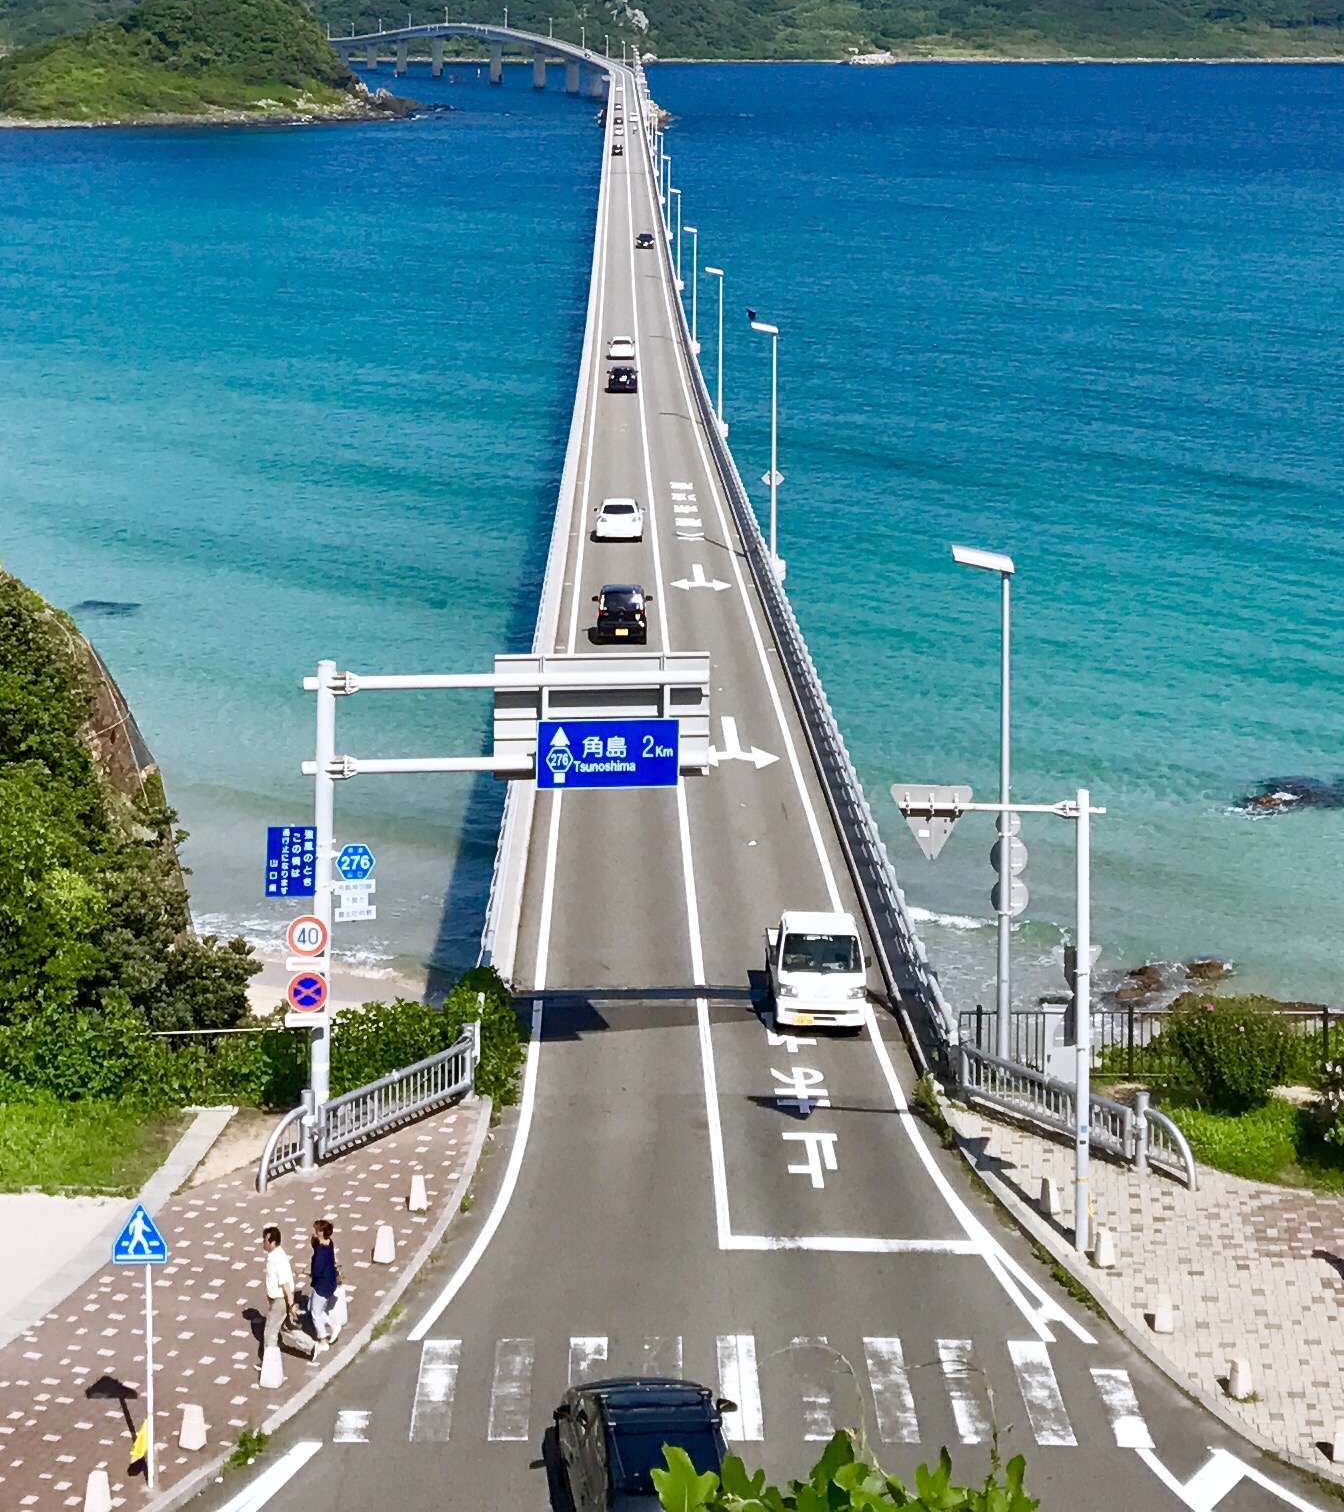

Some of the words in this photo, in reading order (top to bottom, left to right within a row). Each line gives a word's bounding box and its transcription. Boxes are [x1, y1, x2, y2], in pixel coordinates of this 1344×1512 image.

[582, 735, 627, 758] 角島
[551, 753, 569, 767] 276
[573, 759, 636, 773] Tsunoshima
[341, 855, 370, 870] 276
[297, 927, 319, 945] 40
